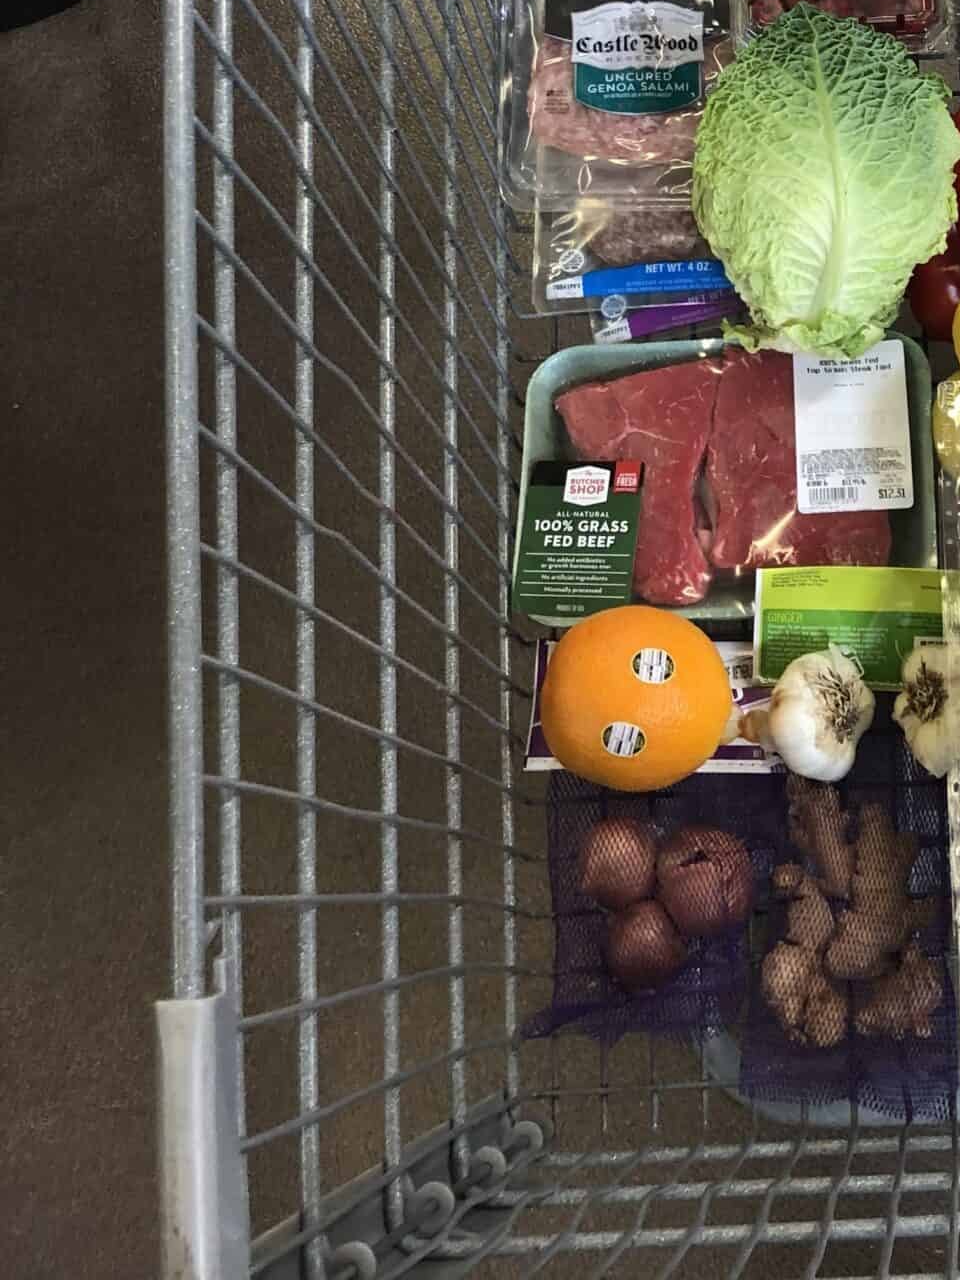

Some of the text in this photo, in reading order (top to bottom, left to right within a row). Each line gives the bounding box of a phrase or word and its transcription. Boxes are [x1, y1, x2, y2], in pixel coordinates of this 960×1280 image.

[576, 33, 698, 55] Castle Wood
[604, 71, 673, 83] UNCURED
[587, 81, 689, 94] GENOA SALAMI
[645, 263, 667, 273] NET
[667, 262, 685, 273] WT.
[687, 262, 695, 271] 4
[569, 485, 605, 495] SHOP
[534, 520, 630, 533] 100% GRASS
[544, 534, 616, 548] FED BEEF
